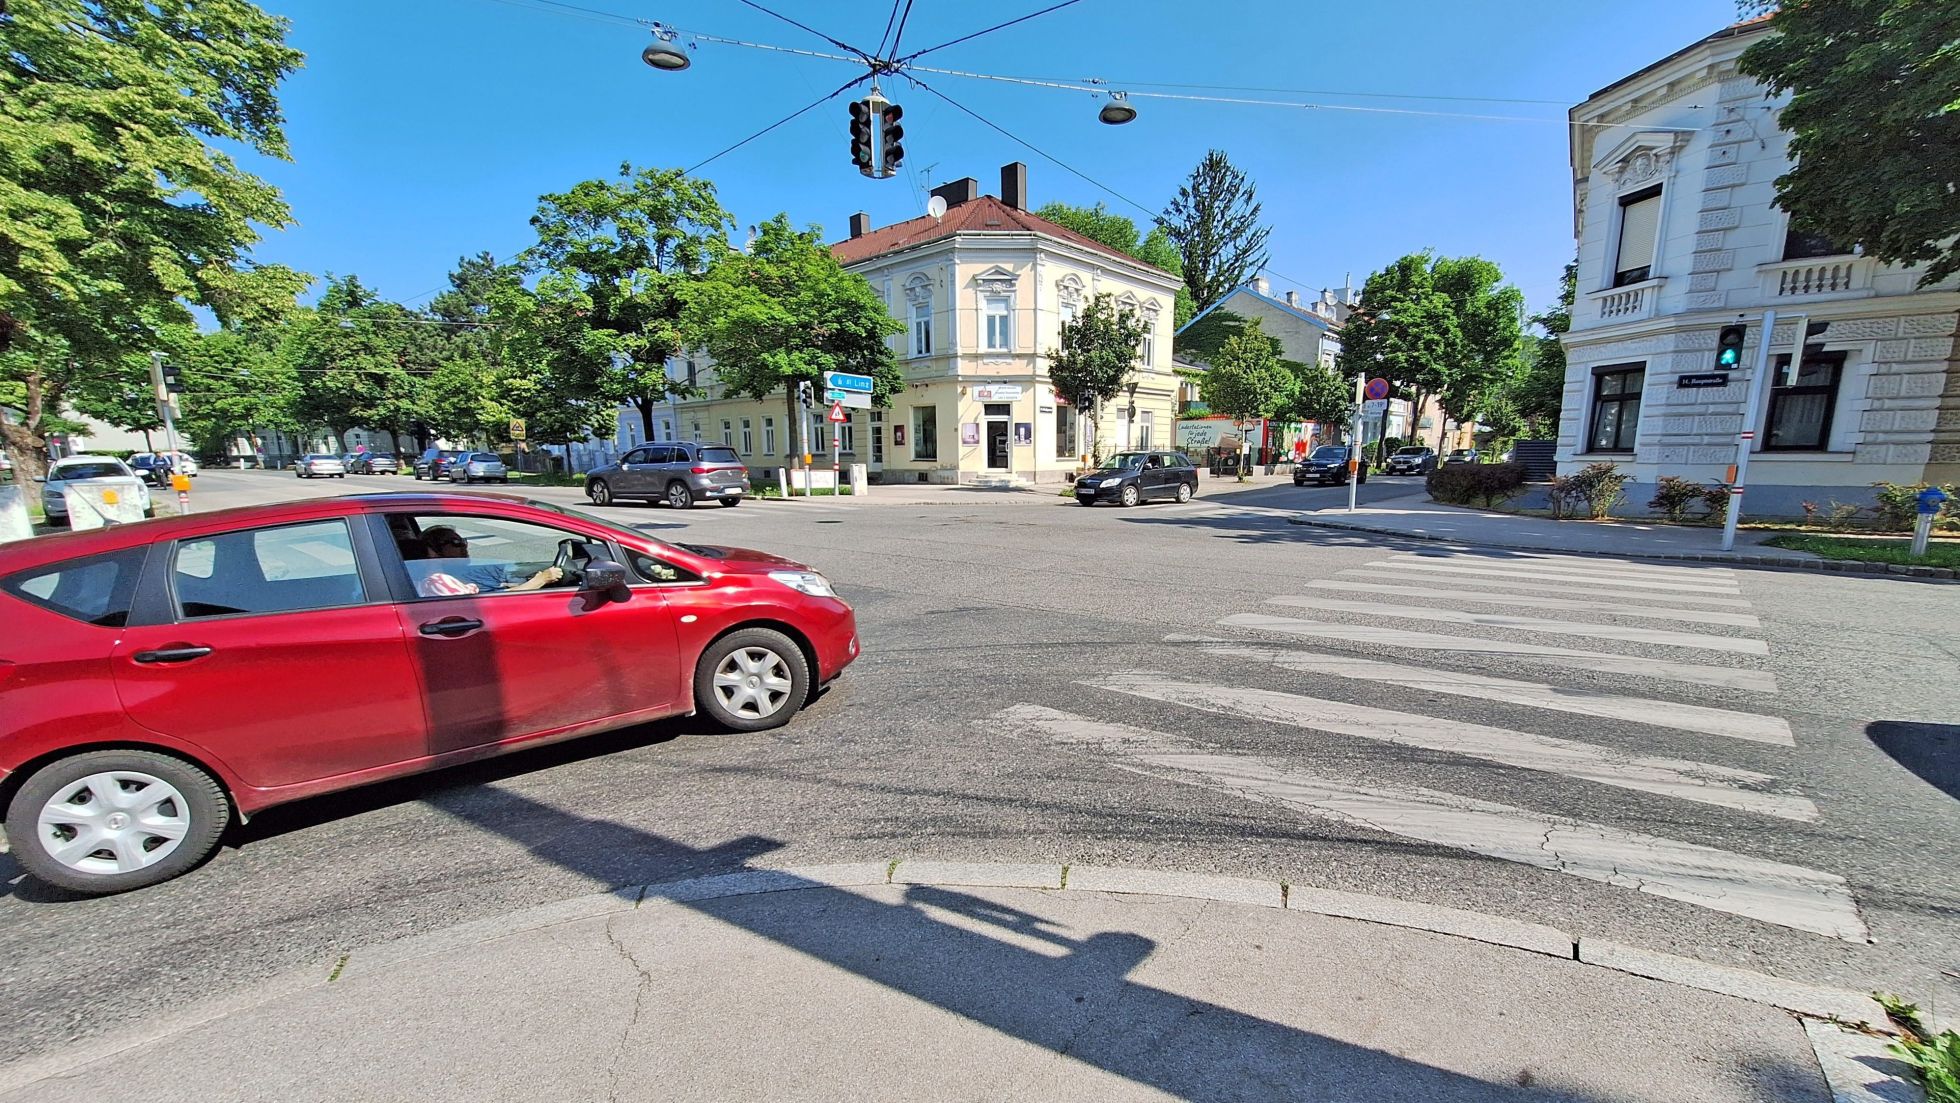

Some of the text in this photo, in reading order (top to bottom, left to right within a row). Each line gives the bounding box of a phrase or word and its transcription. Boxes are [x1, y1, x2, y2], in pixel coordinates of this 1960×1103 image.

[855, 379, 869, 389] Linz
[1178, 423, 1212, 431] Ladestationen
[1194, 430, 1207, 439] jede
[1186, 437, 1211, 446] Straße!
